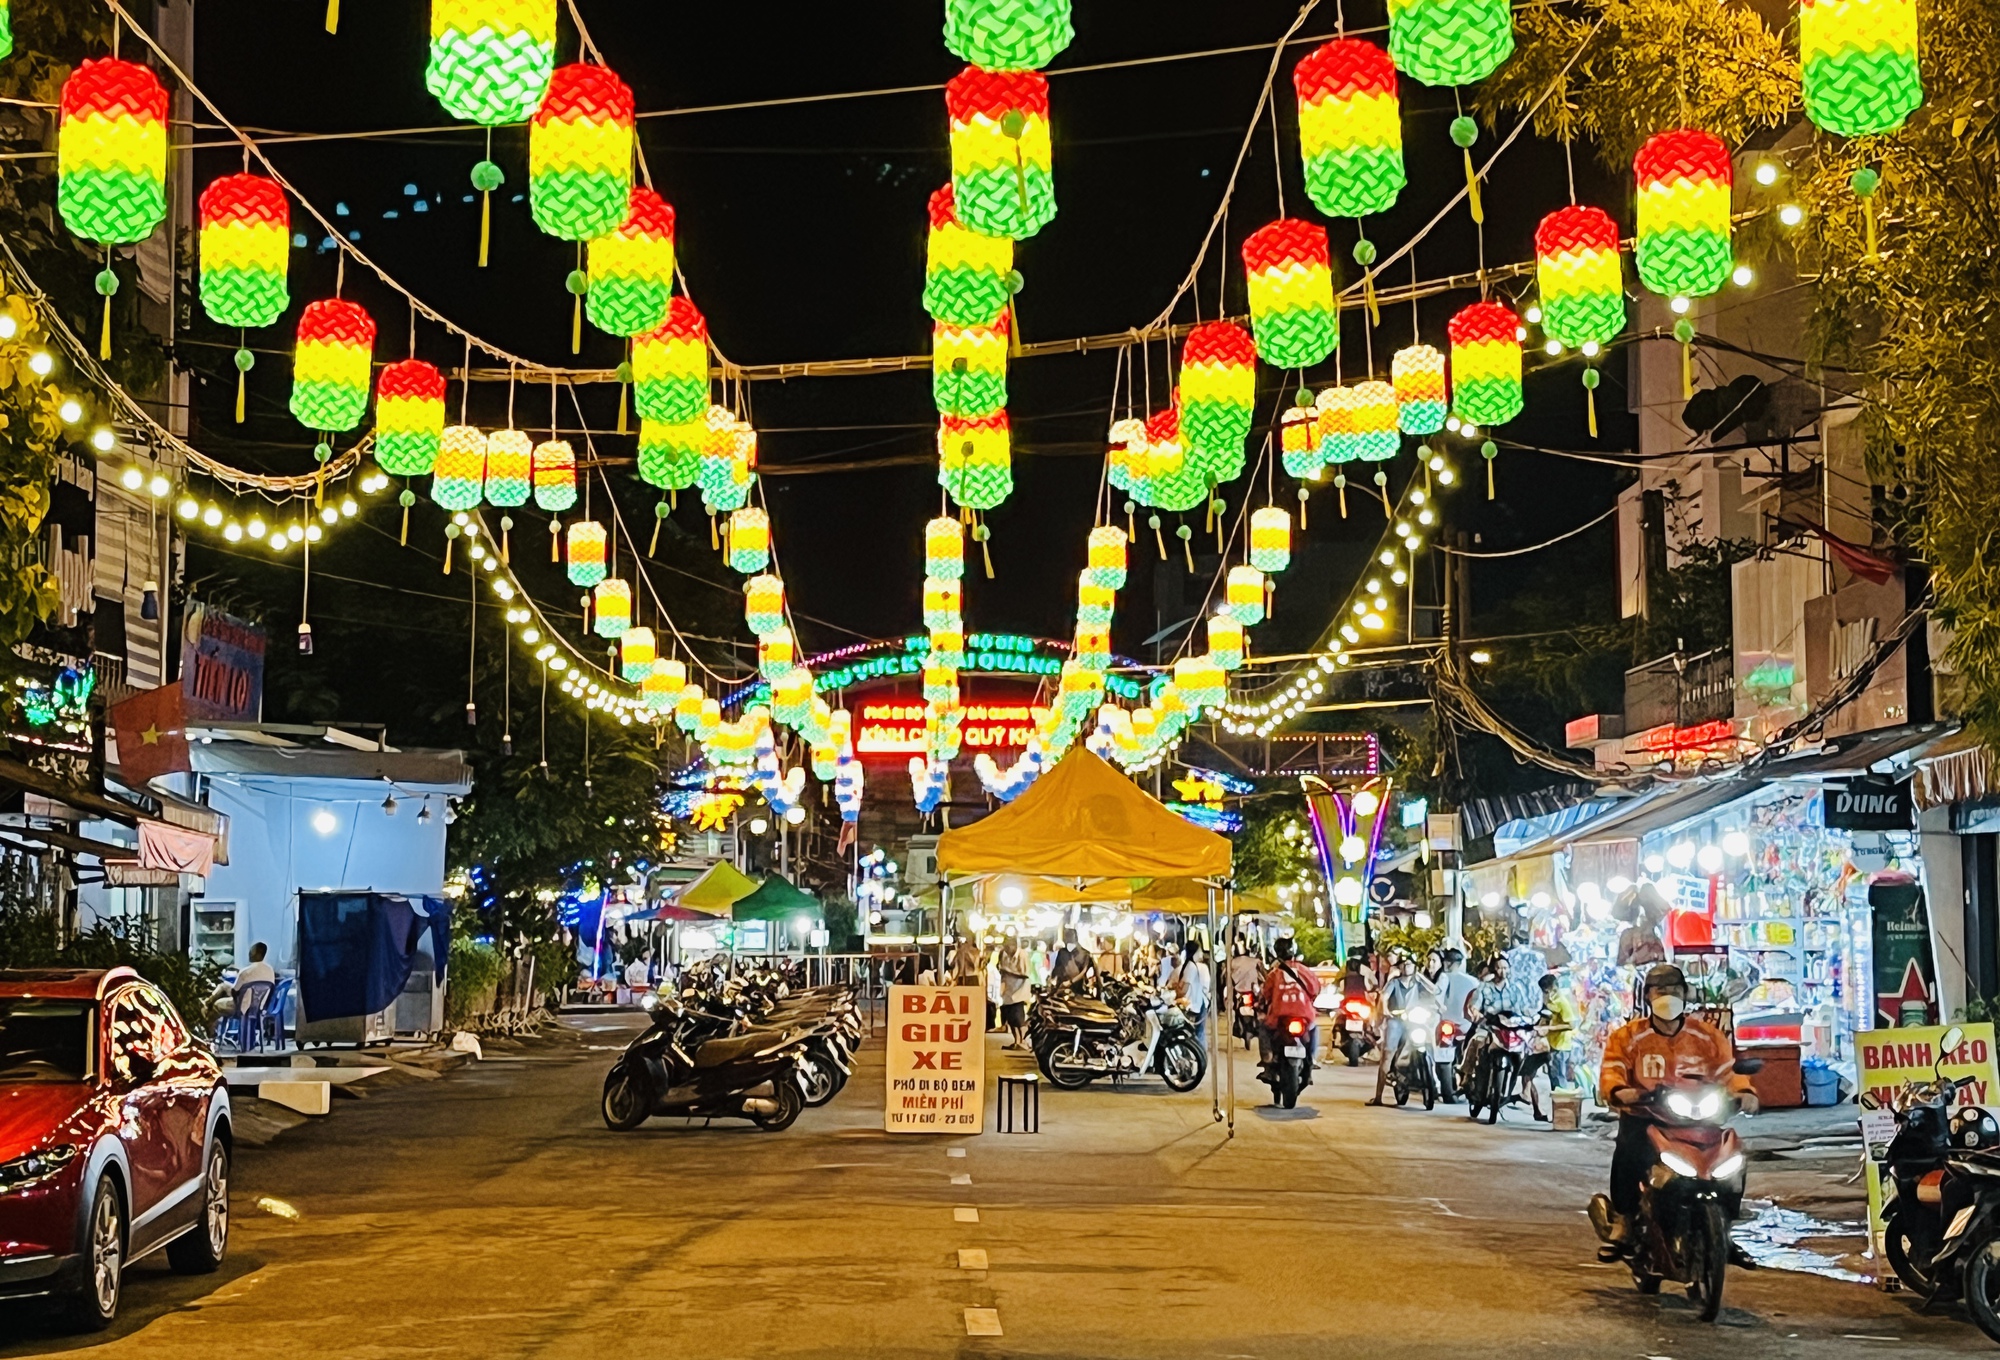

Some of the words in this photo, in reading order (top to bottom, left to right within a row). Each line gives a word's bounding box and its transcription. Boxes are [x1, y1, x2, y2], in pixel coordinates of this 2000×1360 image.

[978, 653, 1062, 675] QUANG
[965, 725, 1006, 746] QUÝ
[902, 990, 969, 1014] BÃI
[901, 1018, 971, 1043] GIỮ
[912, 1051, 962, 1070] XE
[1863, 1040, 1933, 1070] BÁNH
[933, 1078, 948, 1093] BỘ
[941, 1094, 964, 1109] PHÍ
[906, 1113, 917, 1123] 17
[945, 1114, 956, 1124] 23
